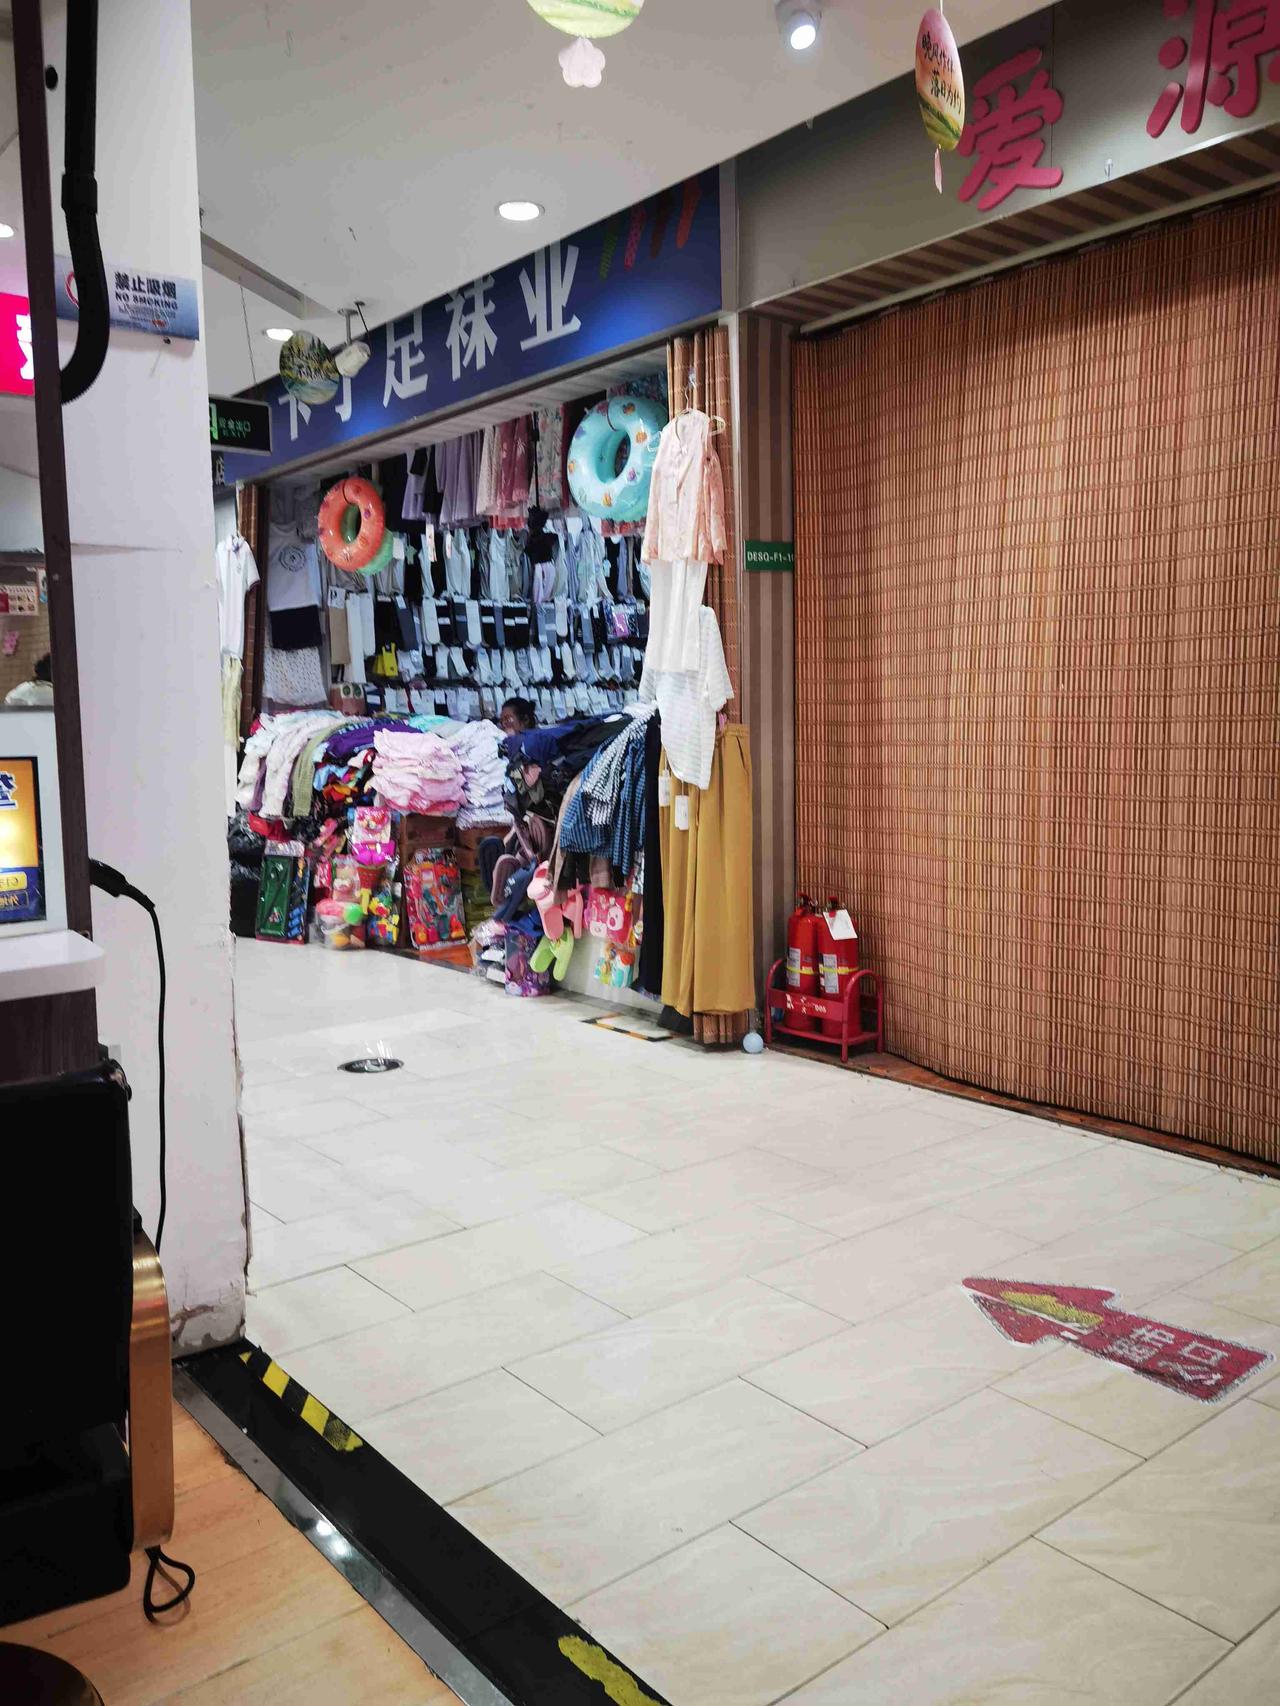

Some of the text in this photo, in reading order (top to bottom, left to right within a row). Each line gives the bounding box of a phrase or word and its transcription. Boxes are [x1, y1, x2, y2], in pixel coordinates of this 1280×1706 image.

[114, 271, 177, 300] 禁止吸烟
[115, 290, 178, 310] NO SMOKING
